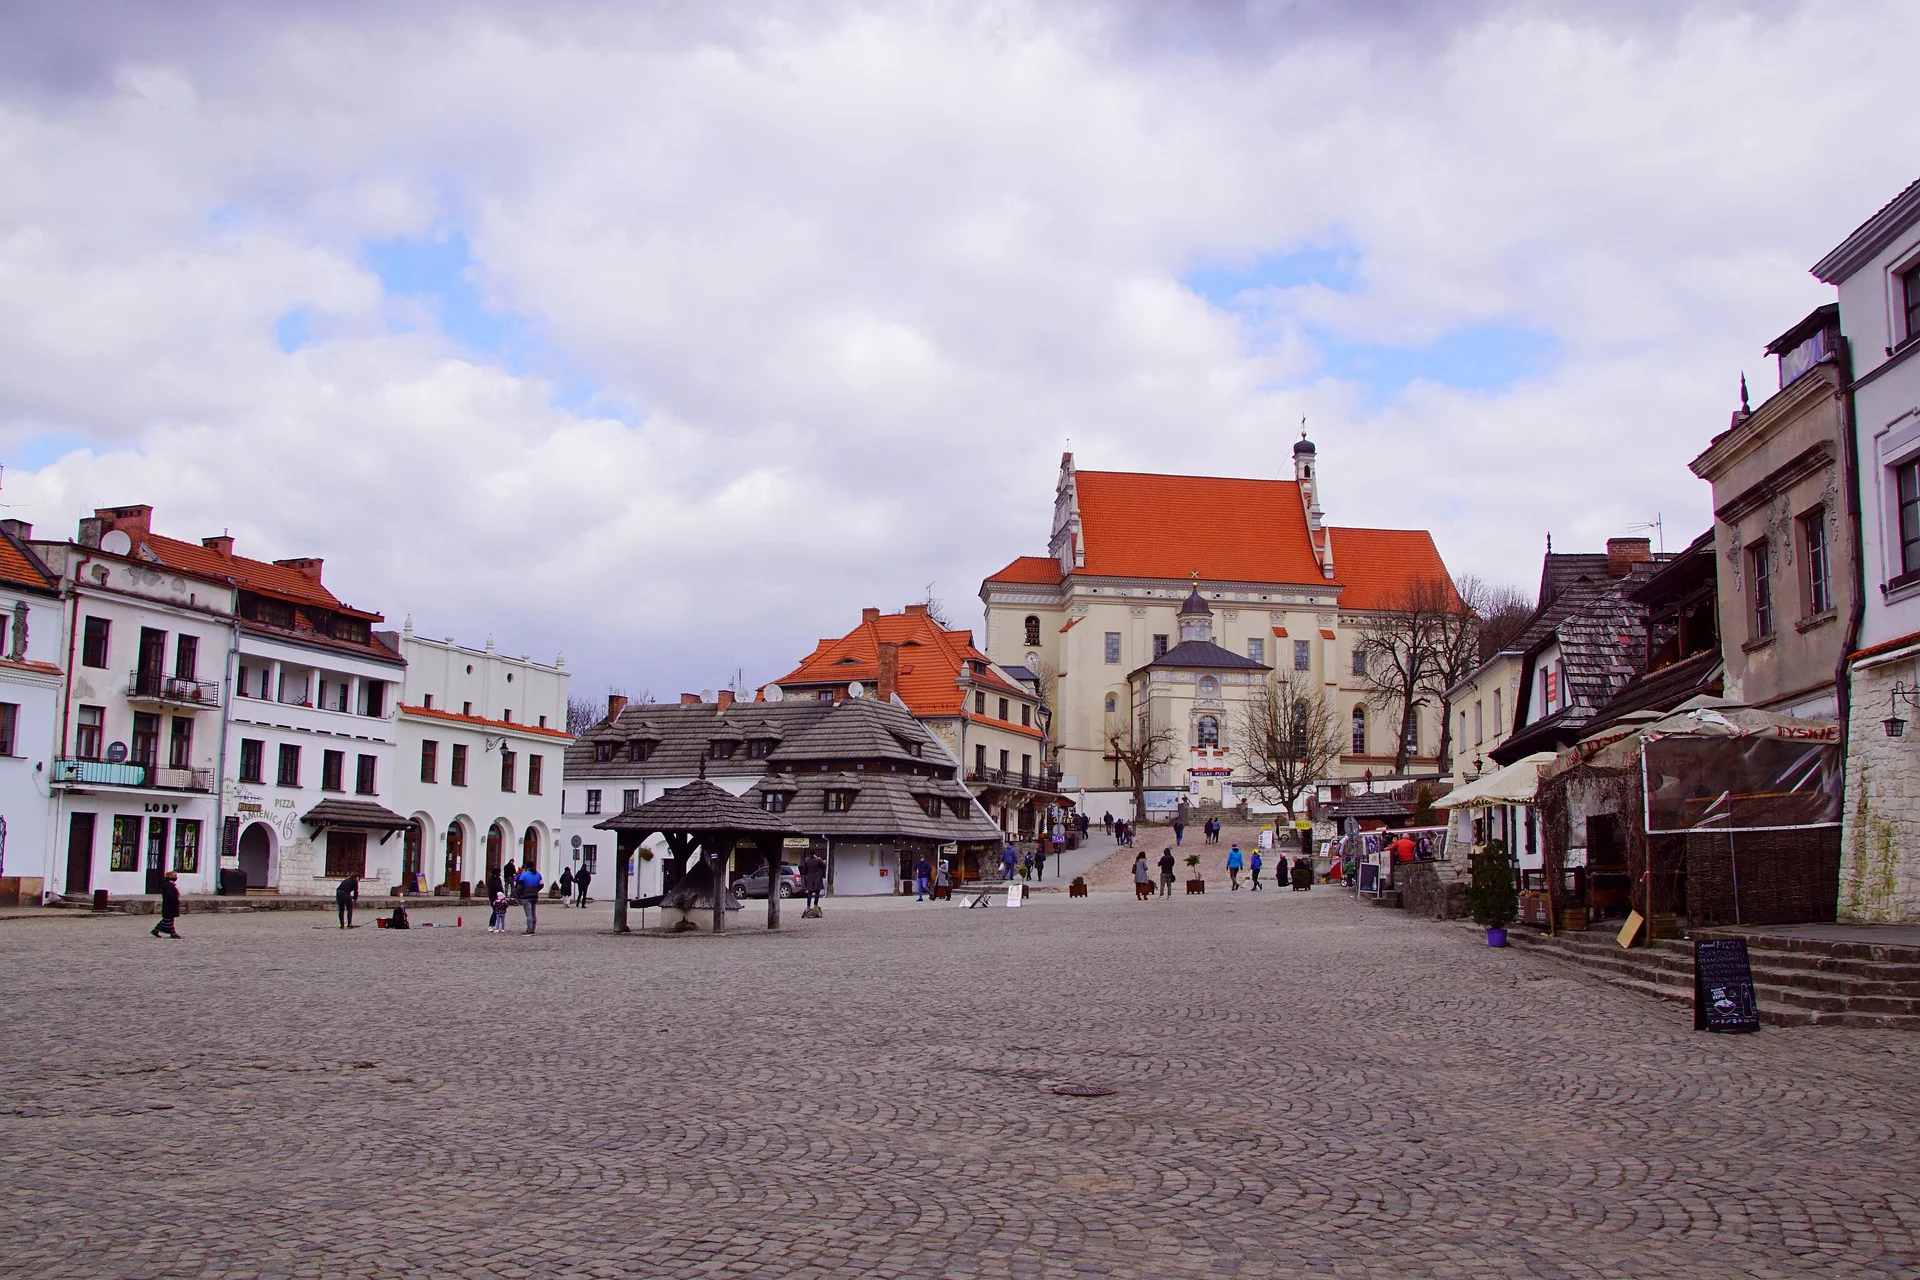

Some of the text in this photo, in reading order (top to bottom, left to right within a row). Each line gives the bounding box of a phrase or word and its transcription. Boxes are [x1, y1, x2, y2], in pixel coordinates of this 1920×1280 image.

[1776, 725, 1837, 741] TYSKIE
[144, 803, 179, 814] LODY
[239, 803, 259, 811] PIZZA
[275, 799, 296, 809] PIZZA
